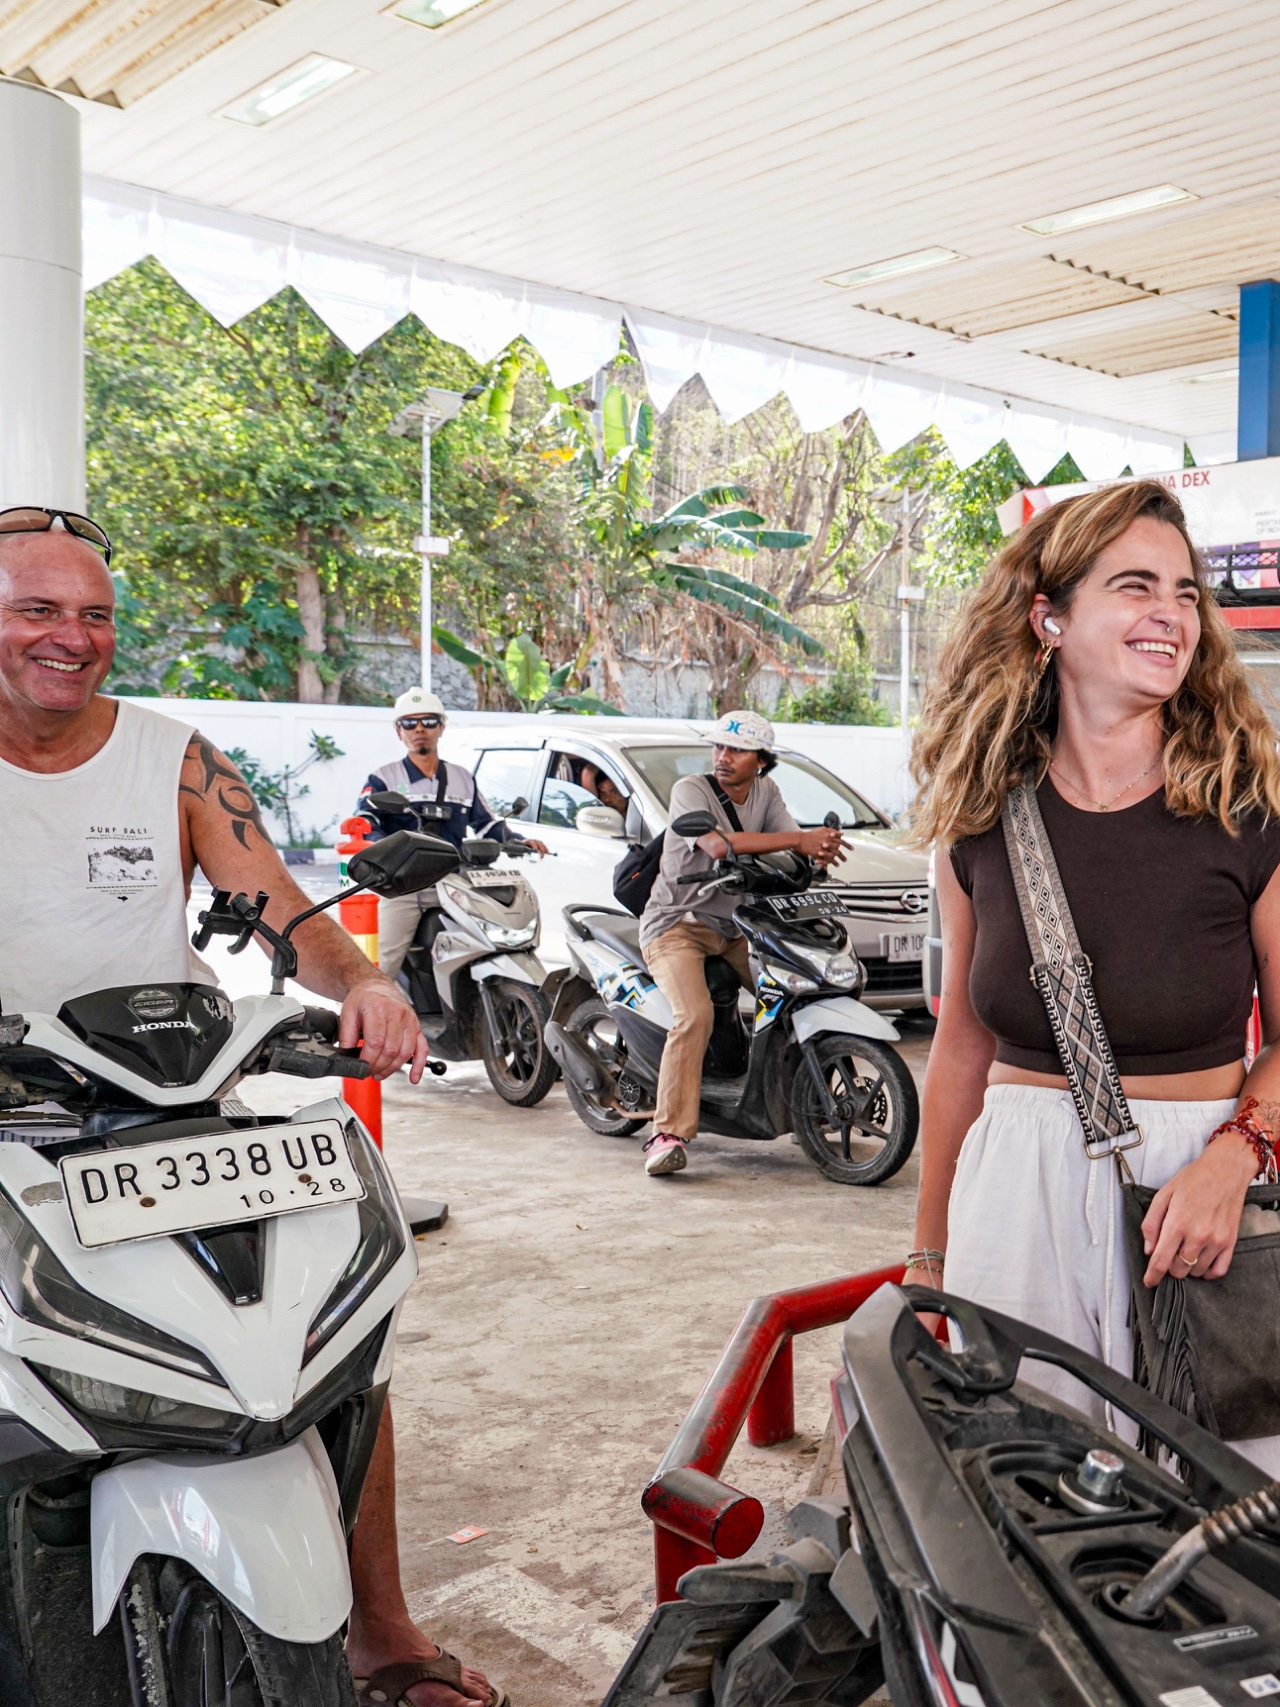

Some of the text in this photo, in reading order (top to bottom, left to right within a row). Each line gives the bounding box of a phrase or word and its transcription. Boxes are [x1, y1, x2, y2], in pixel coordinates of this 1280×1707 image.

[1182, 471, 1210, 488] DEX
[90, 826, 147, 835] SURF BALI
[772, 898, 791, 909] DR
[790, 894, 822, 907] 6994
[894, 934, 926, 953] DR 10
[134, 999, 174, 1008] EIGER
[131, 1020, 198, 1034] HONDA
[80, 1134, 337, 1204] DR 3338 UB
